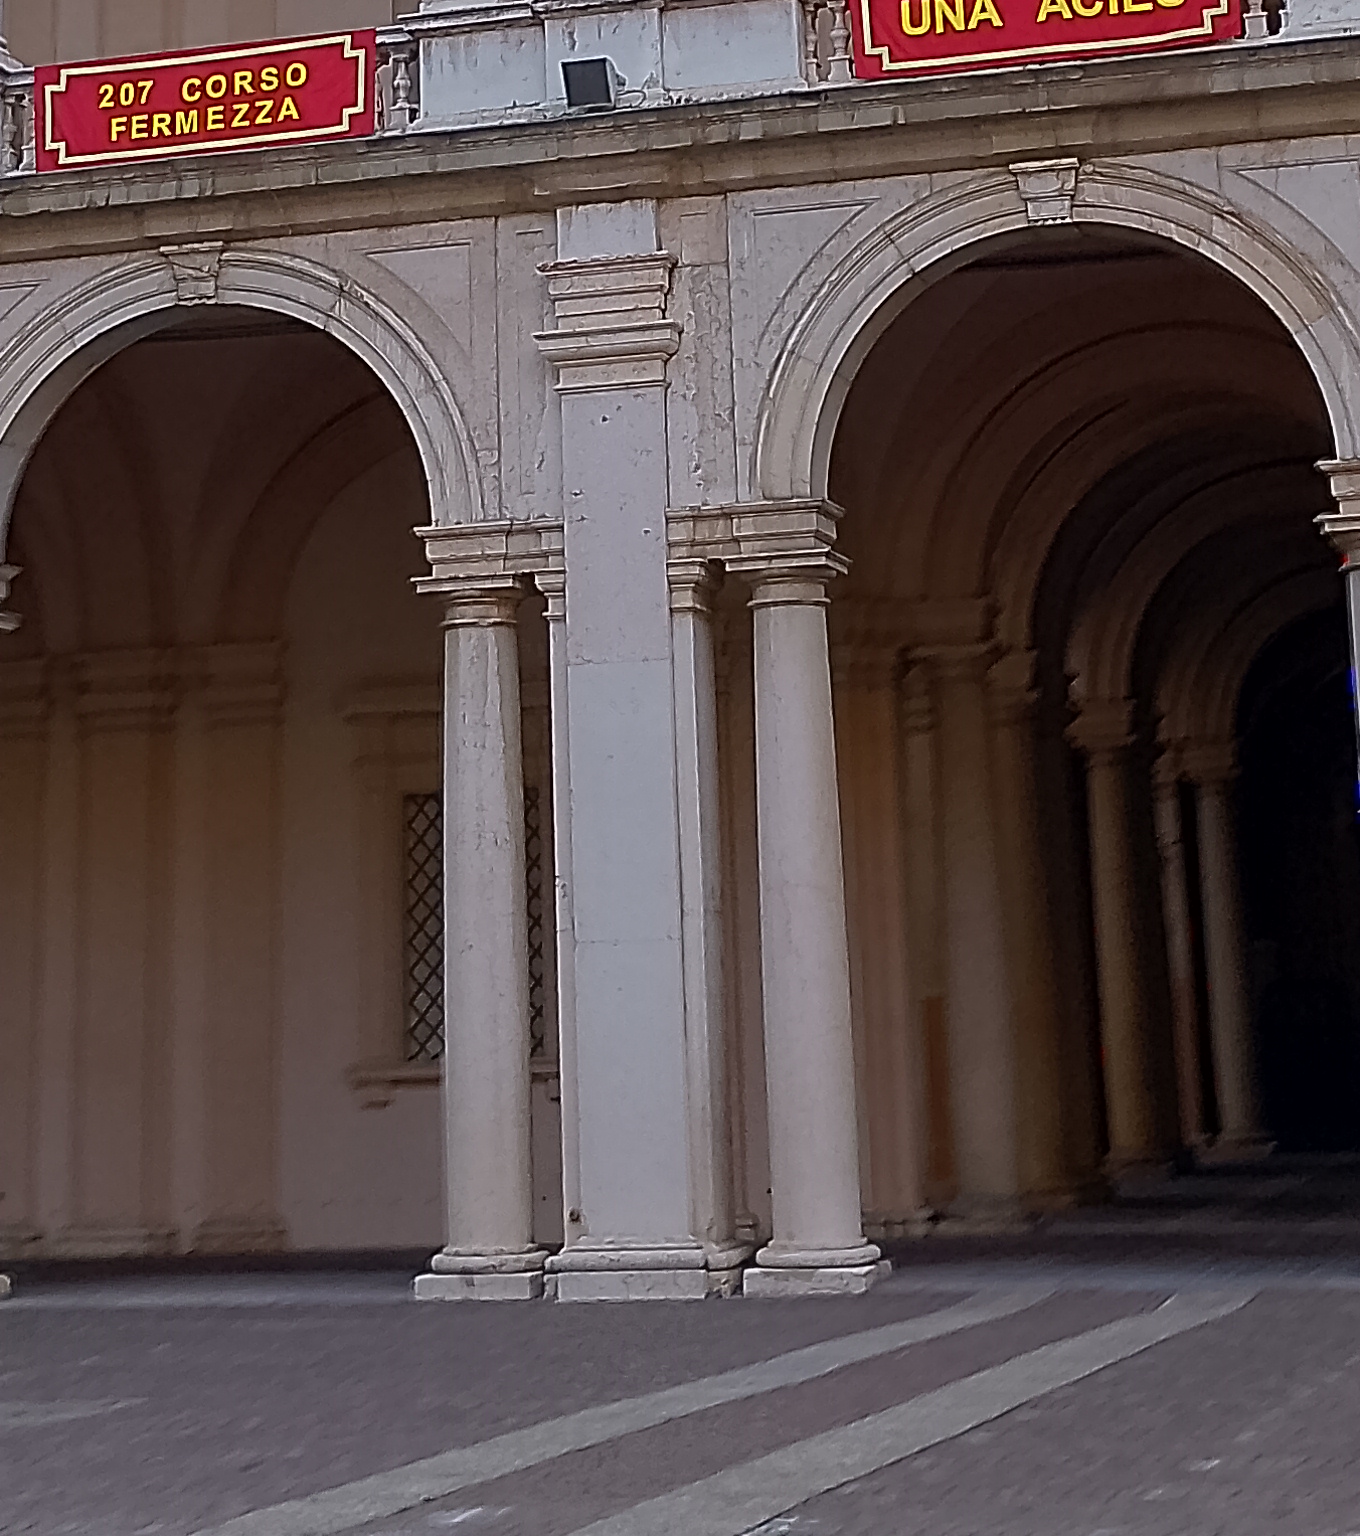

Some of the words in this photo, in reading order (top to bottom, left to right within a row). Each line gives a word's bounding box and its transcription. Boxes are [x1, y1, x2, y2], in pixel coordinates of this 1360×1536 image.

[98, 80, 154, 109] 207
[181, 62, 307, 102] CORSO
[110, 96, 300, 142] FERMEZZA
